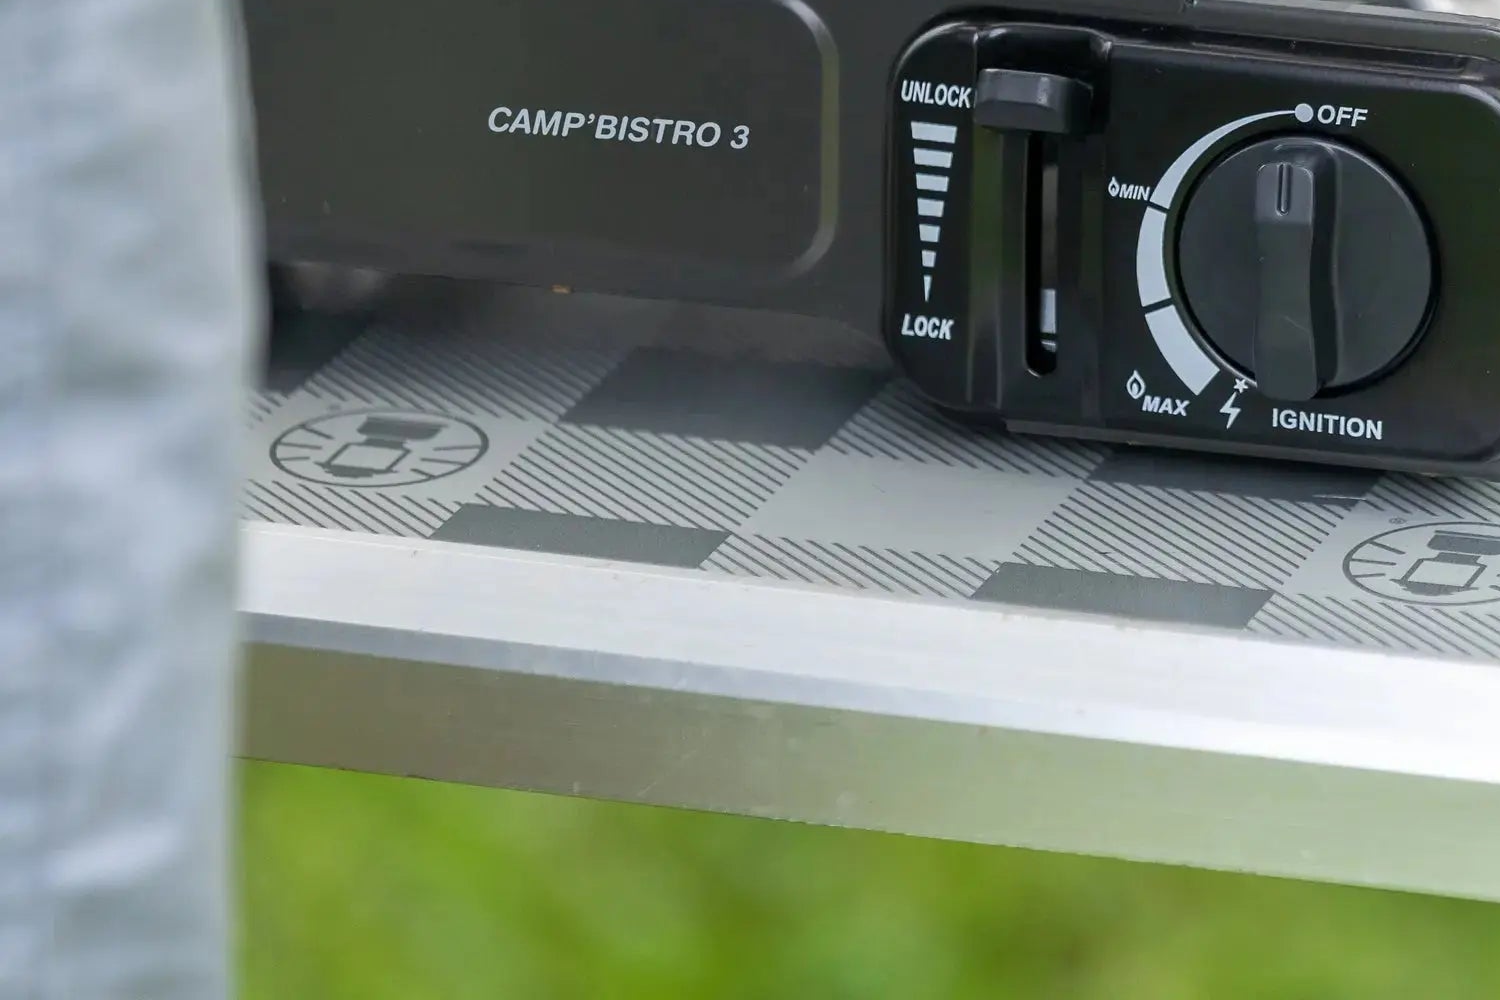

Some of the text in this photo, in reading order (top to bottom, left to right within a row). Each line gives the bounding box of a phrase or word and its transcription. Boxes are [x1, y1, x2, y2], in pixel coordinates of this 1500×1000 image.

[901, 79, 971, 108] UNLOCK
[488, 106, 749, 149] CAMP'BISTRO 3
[1317, 104, 1369, 127] OFF
[1119, 183, 1150, 201] MIN
[901, 313, 954, 341] LOCK
[1141, 395, 1190, 417] MAX
[1272, 407, 1383, 440] IGNITION
